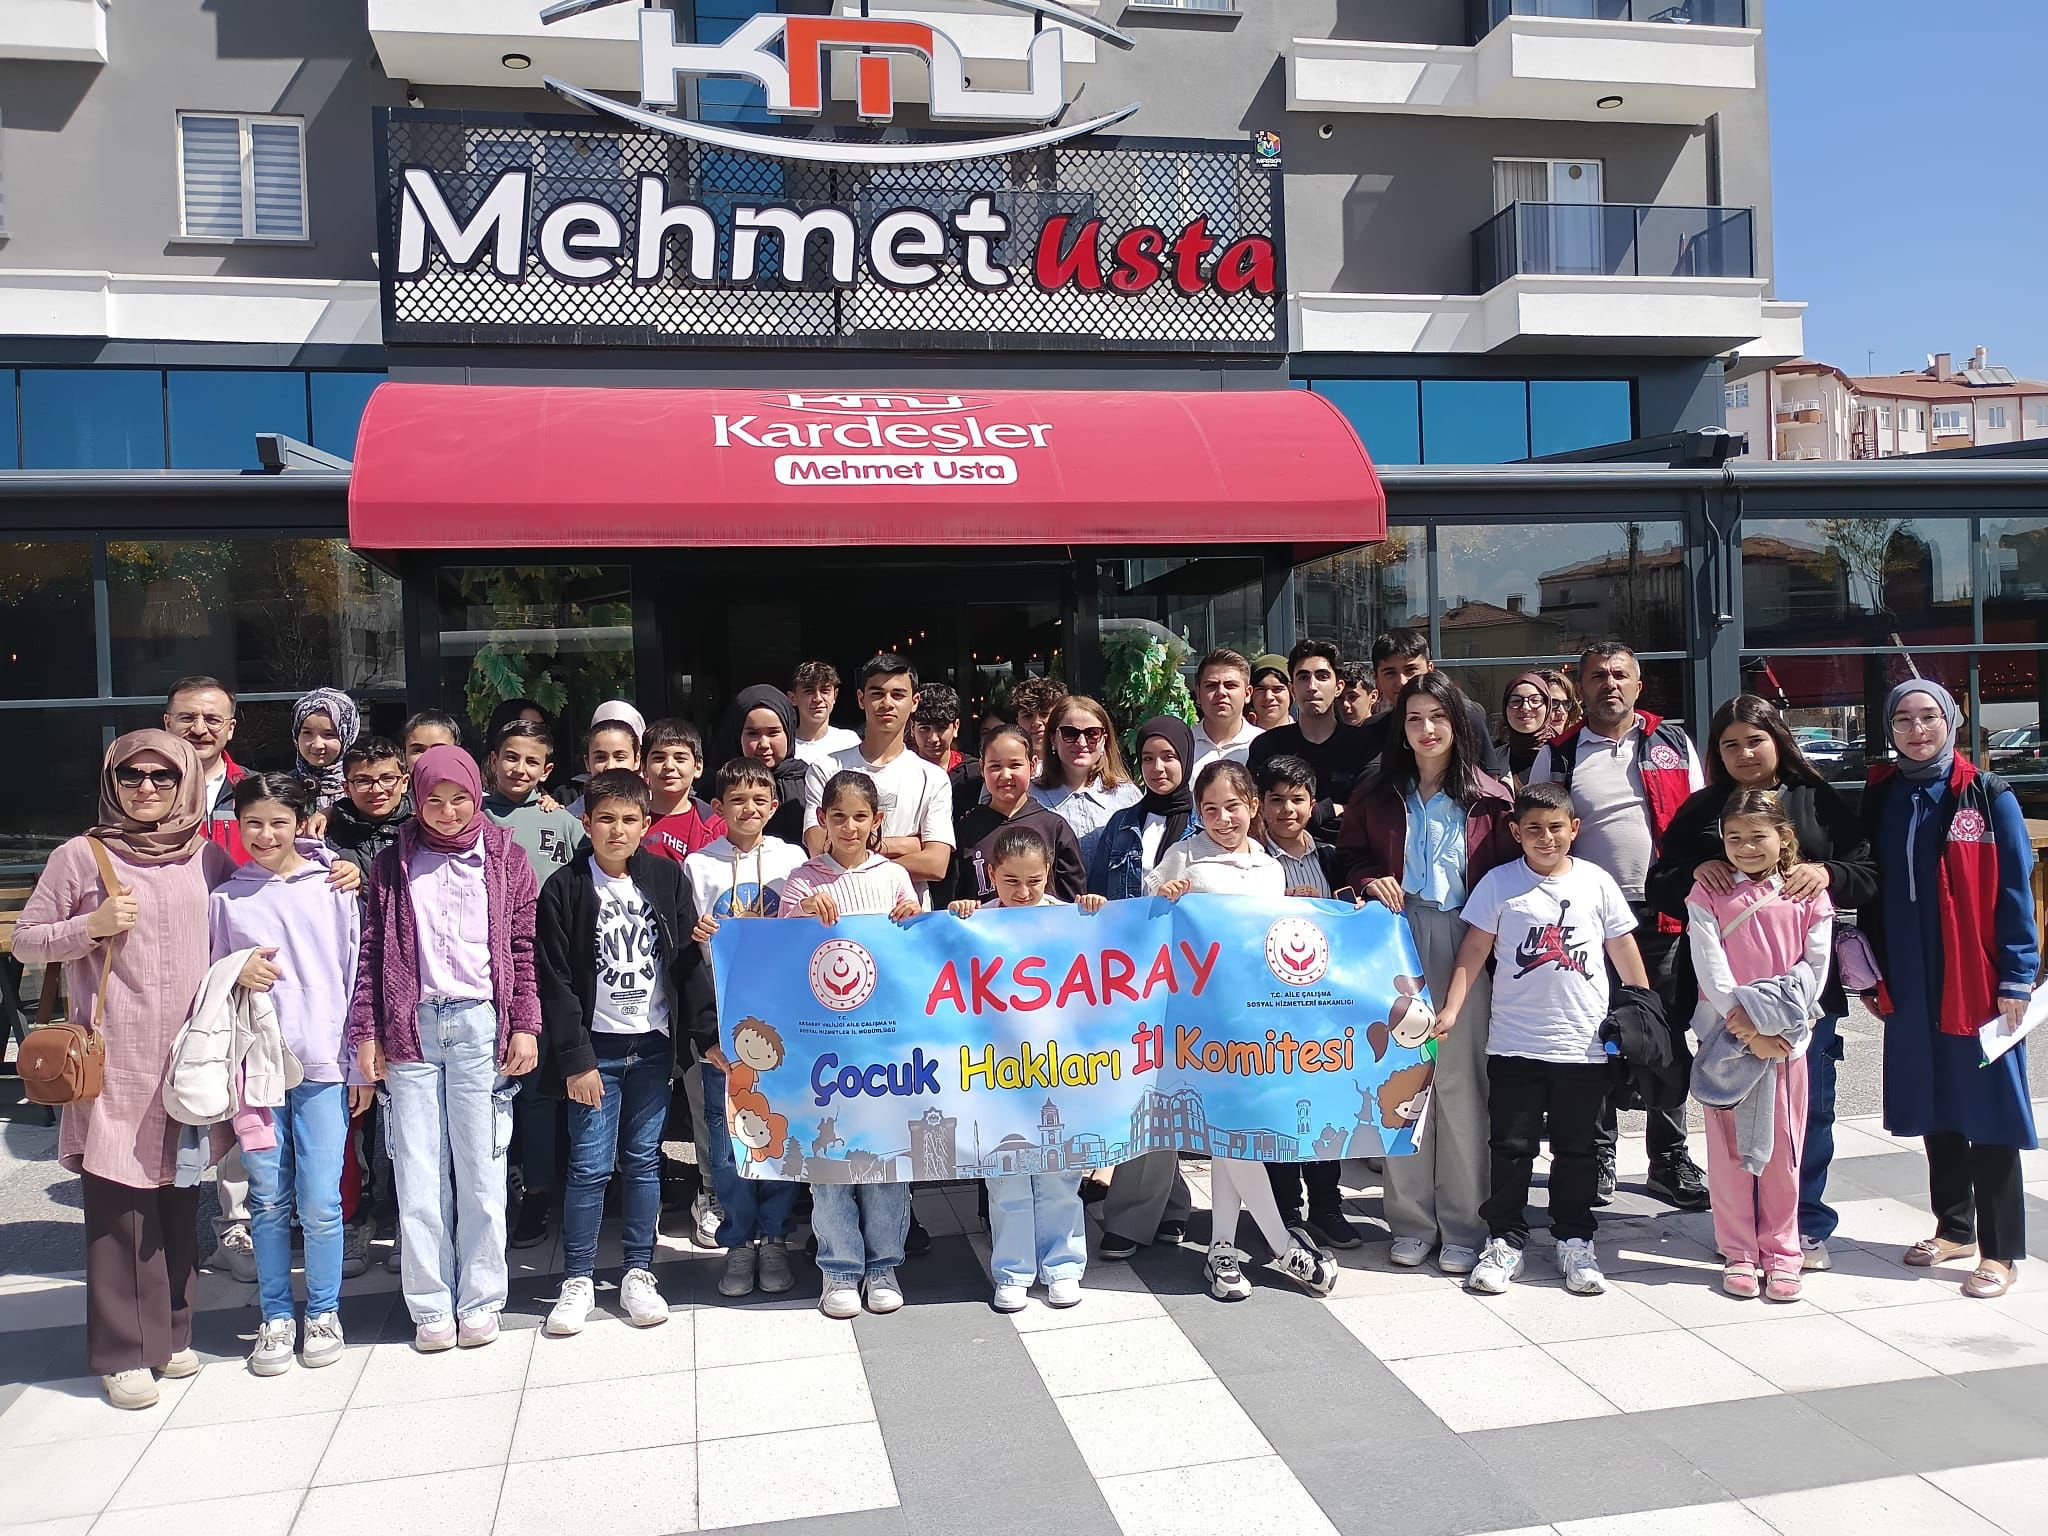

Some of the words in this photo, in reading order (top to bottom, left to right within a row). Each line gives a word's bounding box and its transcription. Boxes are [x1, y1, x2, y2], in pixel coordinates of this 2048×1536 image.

[396, 166, 1010, 288] Mehmet
[1034, 214, 1277, 295] Usta
[712, 415, 1053, 453] Kardeşler
[790, 460, 924, 480] Mehmet
[934, 460, 1005, 480] Usta
[603, 923, 652, 963] NYC
[924, 941, 1221, 1016] AKSARAY
[810, 1047, 941, 1106] Çocuk
[959, 1039, 1122, 1092] Hakları
[1131, 1021, 1164, 1075] İl
[1175, 1024, 1355, 1076] Komitesi
